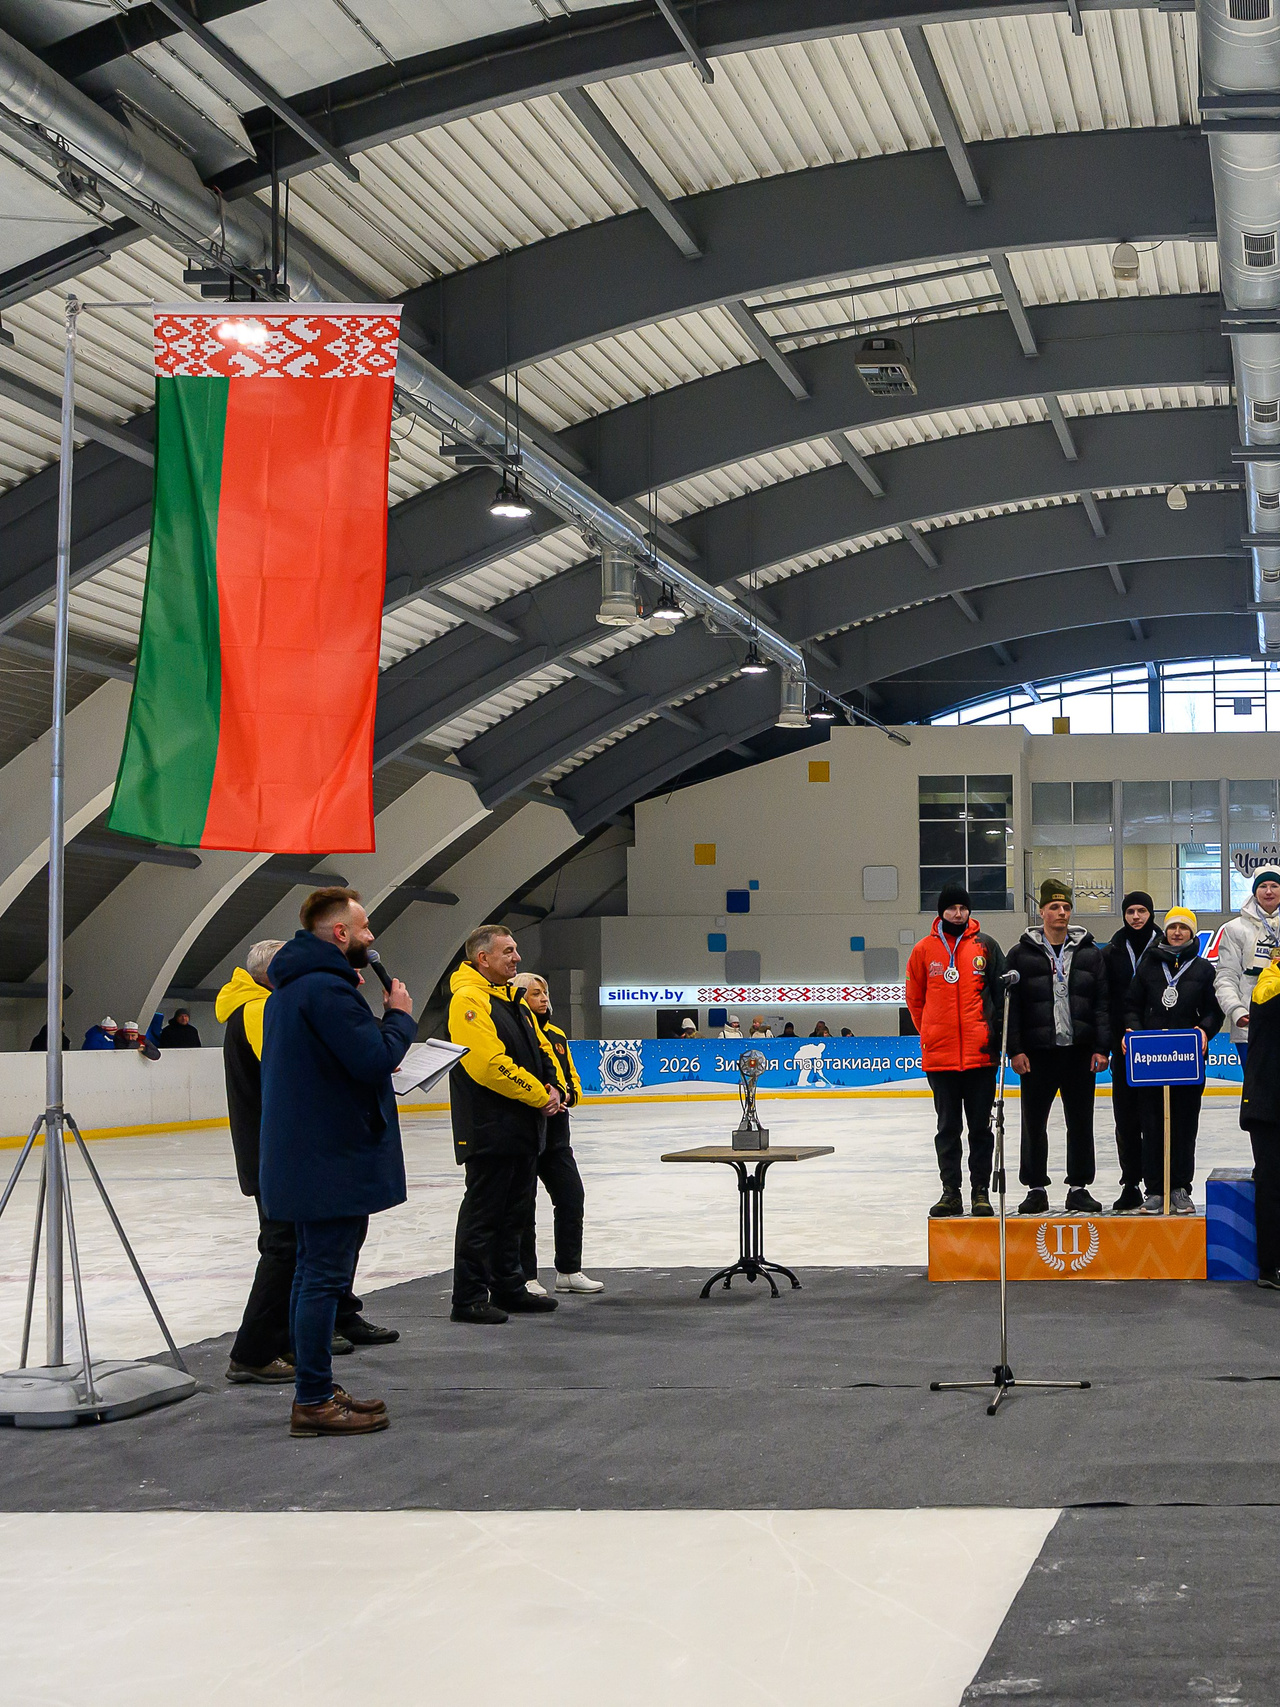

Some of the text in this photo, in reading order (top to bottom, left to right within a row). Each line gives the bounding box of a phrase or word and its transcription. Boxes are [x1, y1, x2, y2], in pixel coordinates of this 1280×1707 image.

[608, 989, 684, 1002] silichy.by
[659, 1057, 700, 1073] 2026
[715, 1056, 779, 1073] Зия
[783, 1056, 892, 1077] спартакиада
[895, 1056, 923, 1073] сре
[1134, 1050, 1195, 1066] Агрохолдинг
[497, 1064, 533, 1092] BELARUS
[1052, 1224, 1083, 1255] II
